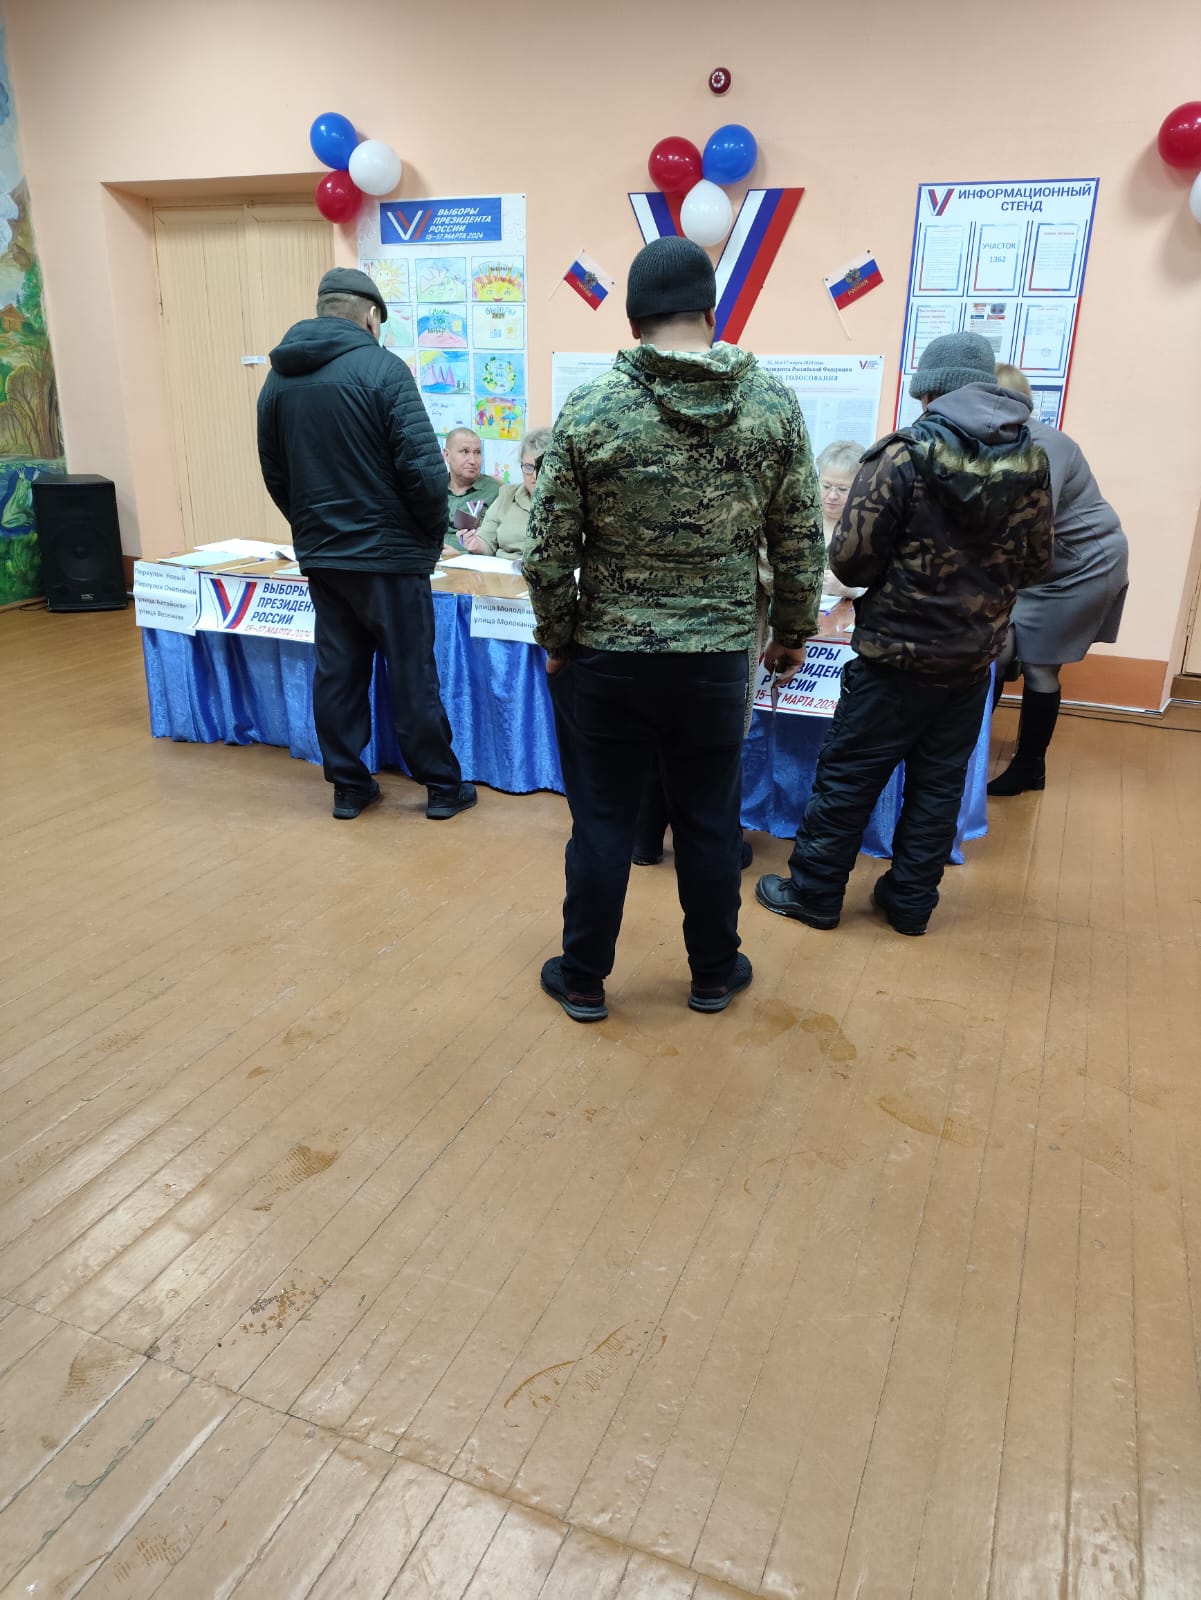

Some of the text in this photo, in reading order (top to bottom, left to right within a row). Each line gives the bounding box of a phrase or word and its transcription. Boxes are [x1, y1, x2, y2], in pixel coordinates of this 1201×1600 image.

[958, 183, 1092, 200] ИНФОРМАЦИОННЫЙ
[437, 208, 480, 216] ВЫБОРЫ
[1001, 200, 1043, 213] СТЕНД
[433, 216, 492, 225] ПРЕЗИДЕНТА
[428, 225, 467, 233] РОССИИ
[982, 242, 1017, 250] УЧАСТОК
[263, 582, 310, 597] ВЫБОРЫ
[257, 597, 315, 613] ПРЕЗИДЕН
[474, 603, 495, 611] улица
[250, 611, 295, 625] РОССИИ
[473, 617, 495, 625] улица
[781, 693, 815, 707] МАРТА
